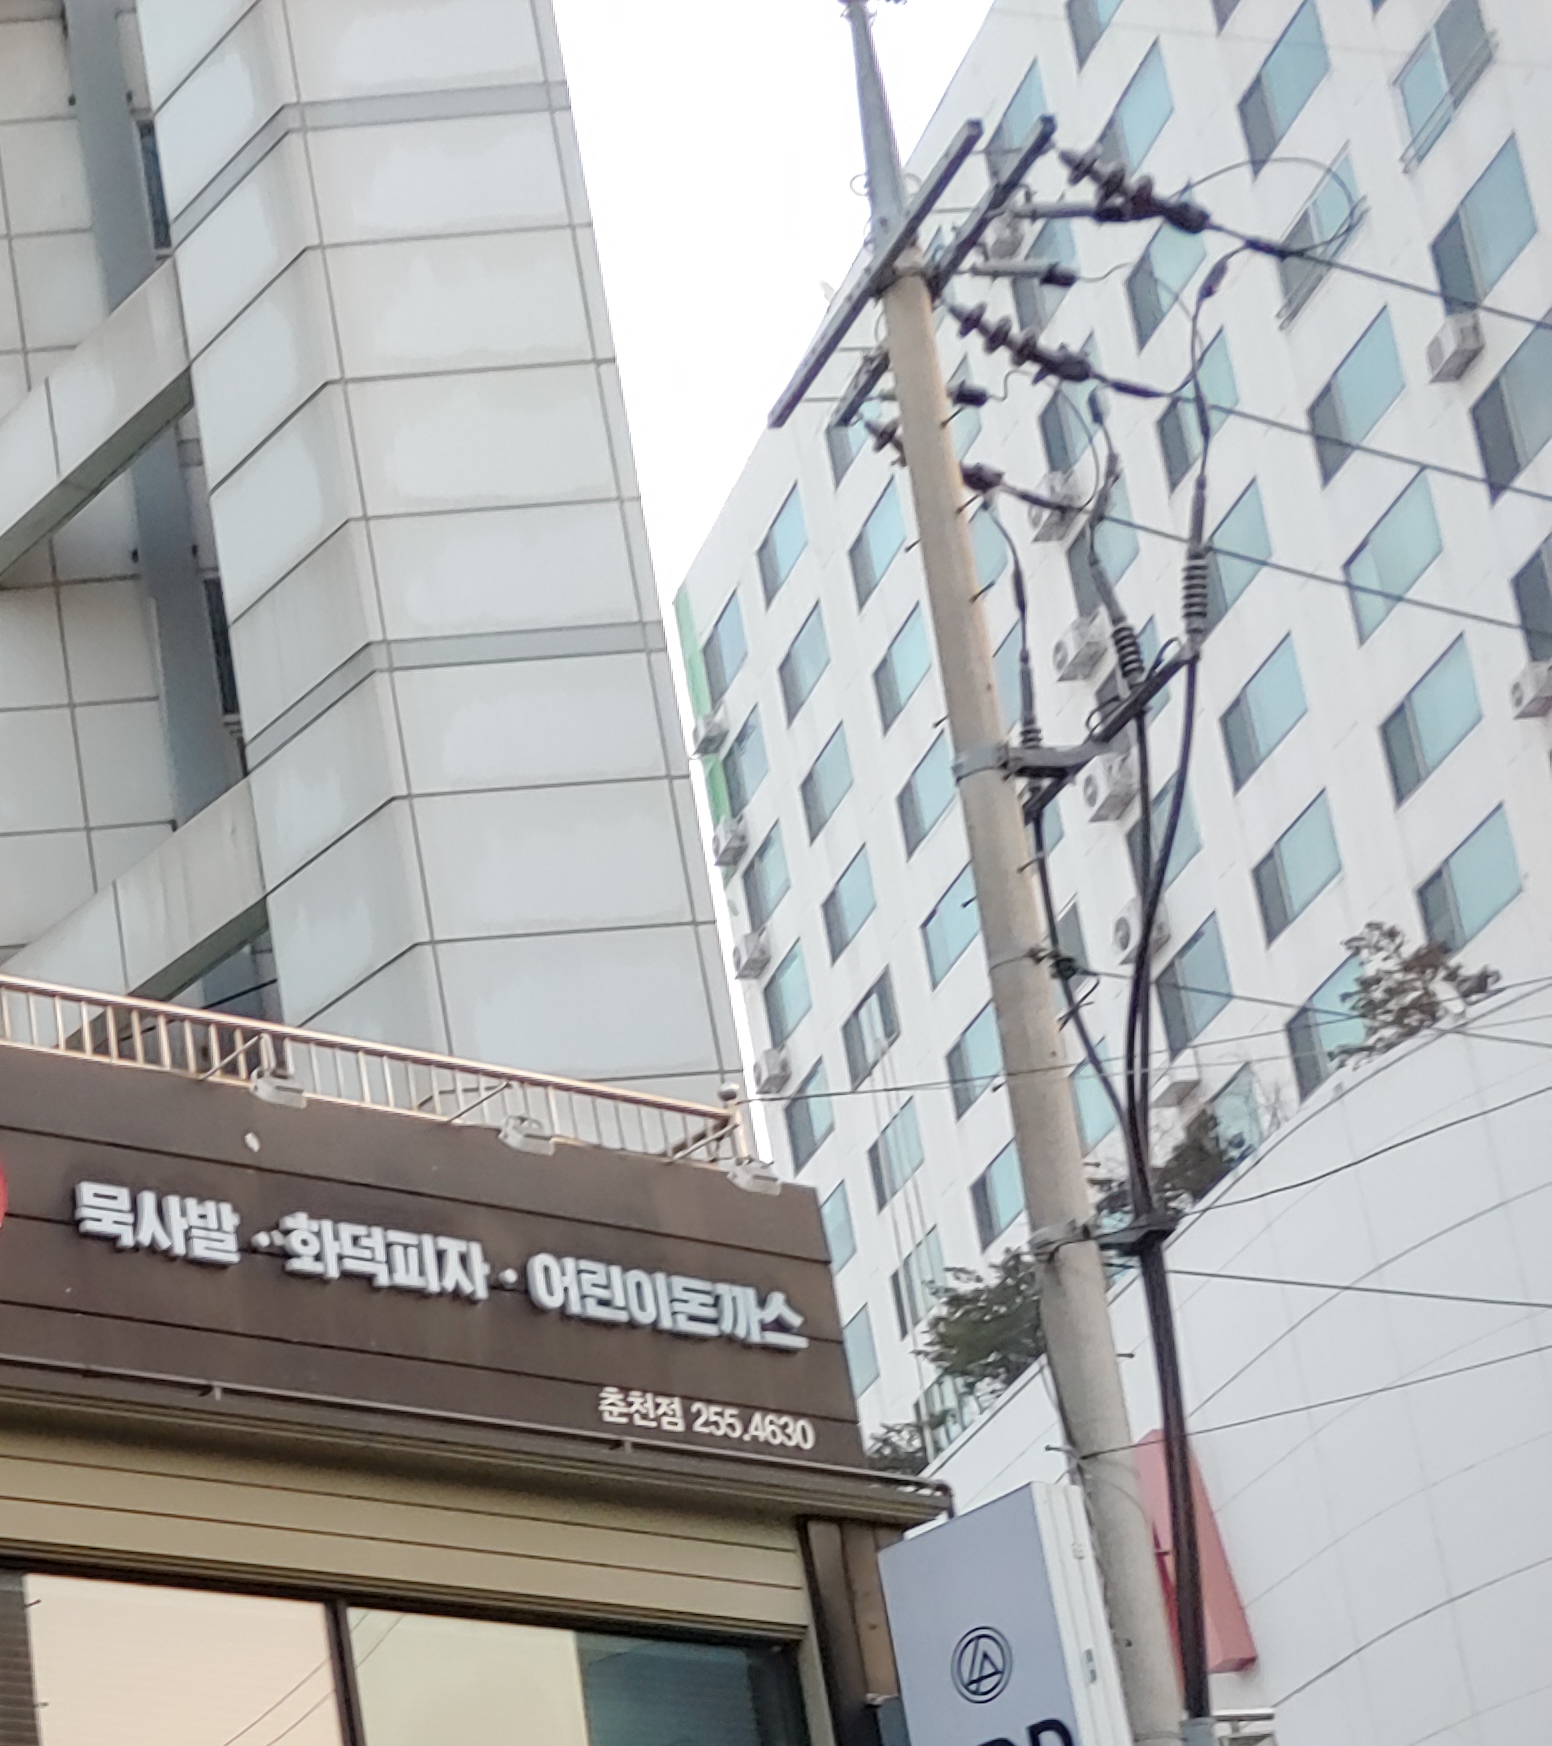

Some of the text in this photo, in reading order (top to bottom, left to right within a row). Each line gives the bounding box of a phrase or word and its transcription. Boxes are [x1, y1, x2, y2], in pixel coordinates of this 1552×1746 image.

[74, 1180, 811, 1351] 묵사발 화덕피자 어린이돈까스
[598, 1386, 815, 1450] 춘천점 255.4630
